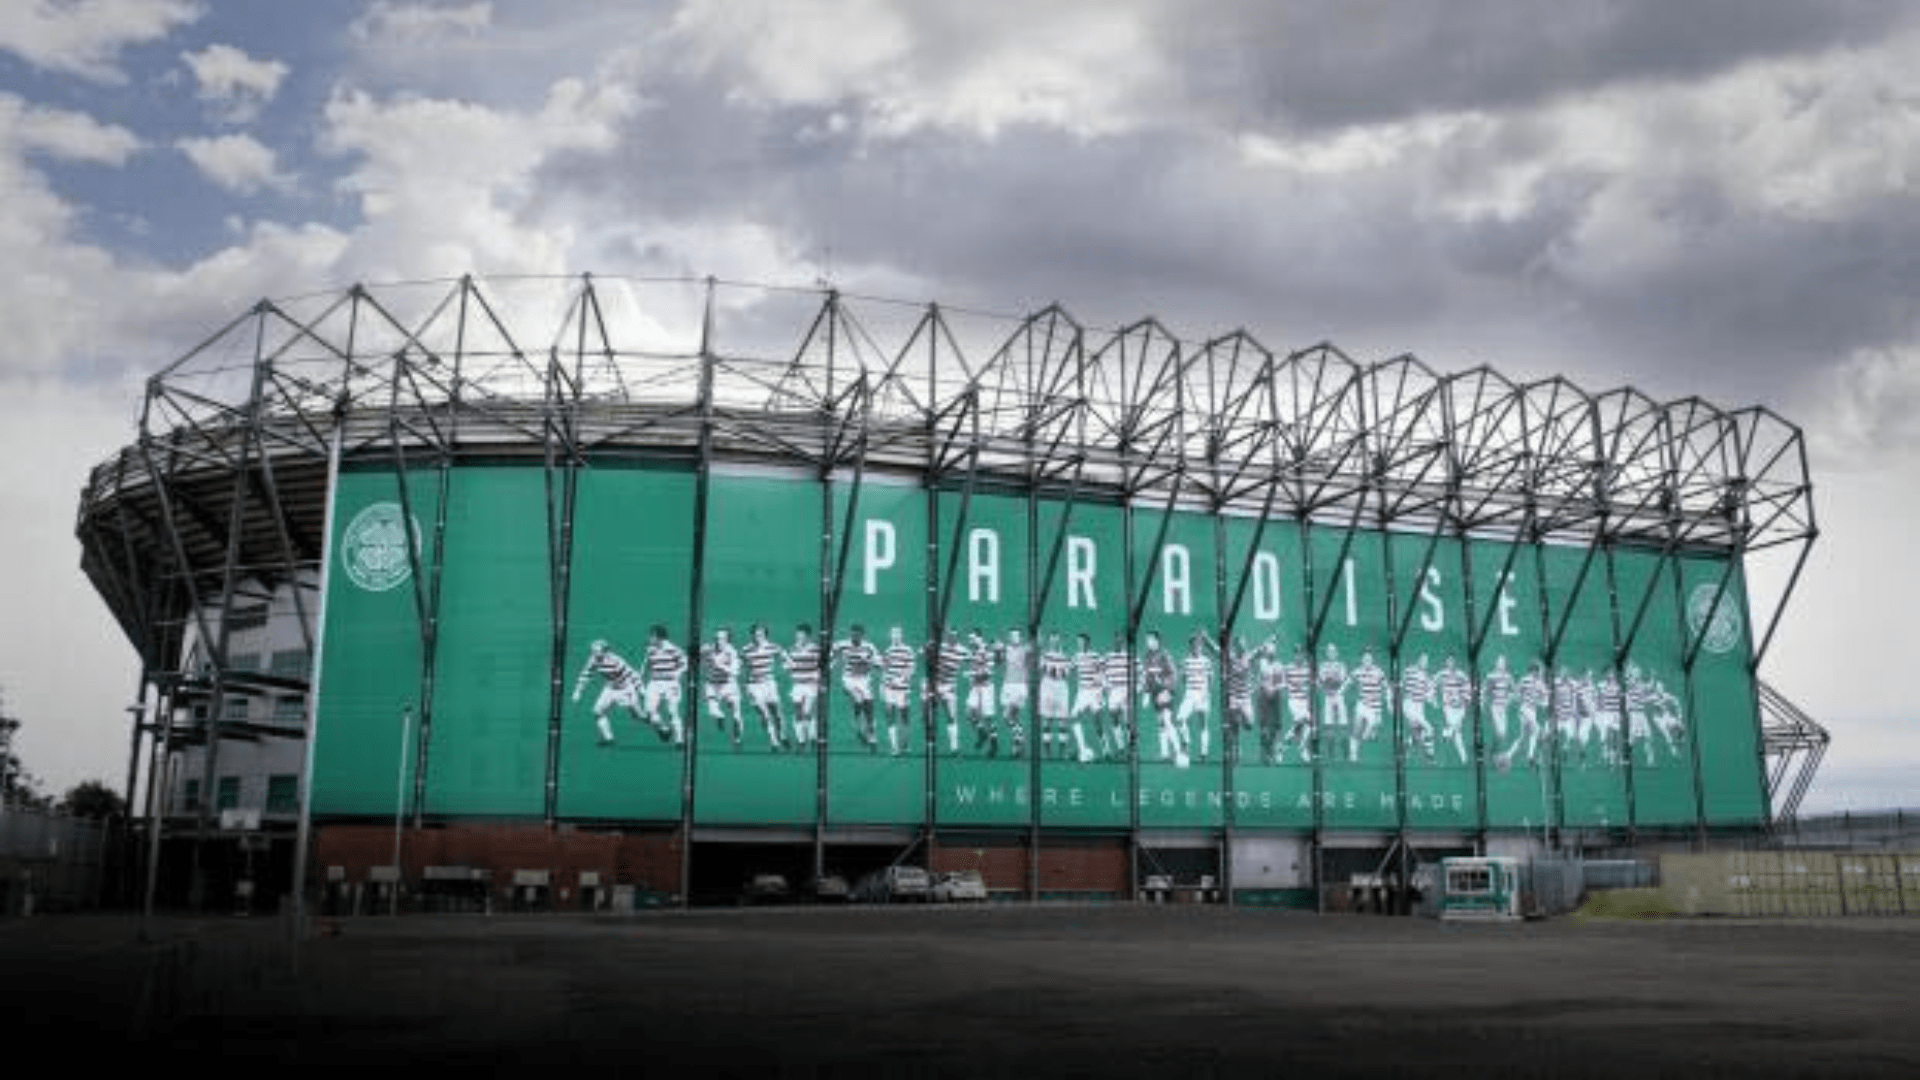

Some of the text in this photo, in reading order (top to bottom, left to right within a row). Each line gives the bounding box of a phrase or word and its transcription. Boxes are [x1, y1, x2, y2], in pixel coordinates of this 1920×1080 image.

[864, 519, 1520, 636] PARADISE
[955, 785, 1463, 811] WHERE LEGENDS ARE MADE
